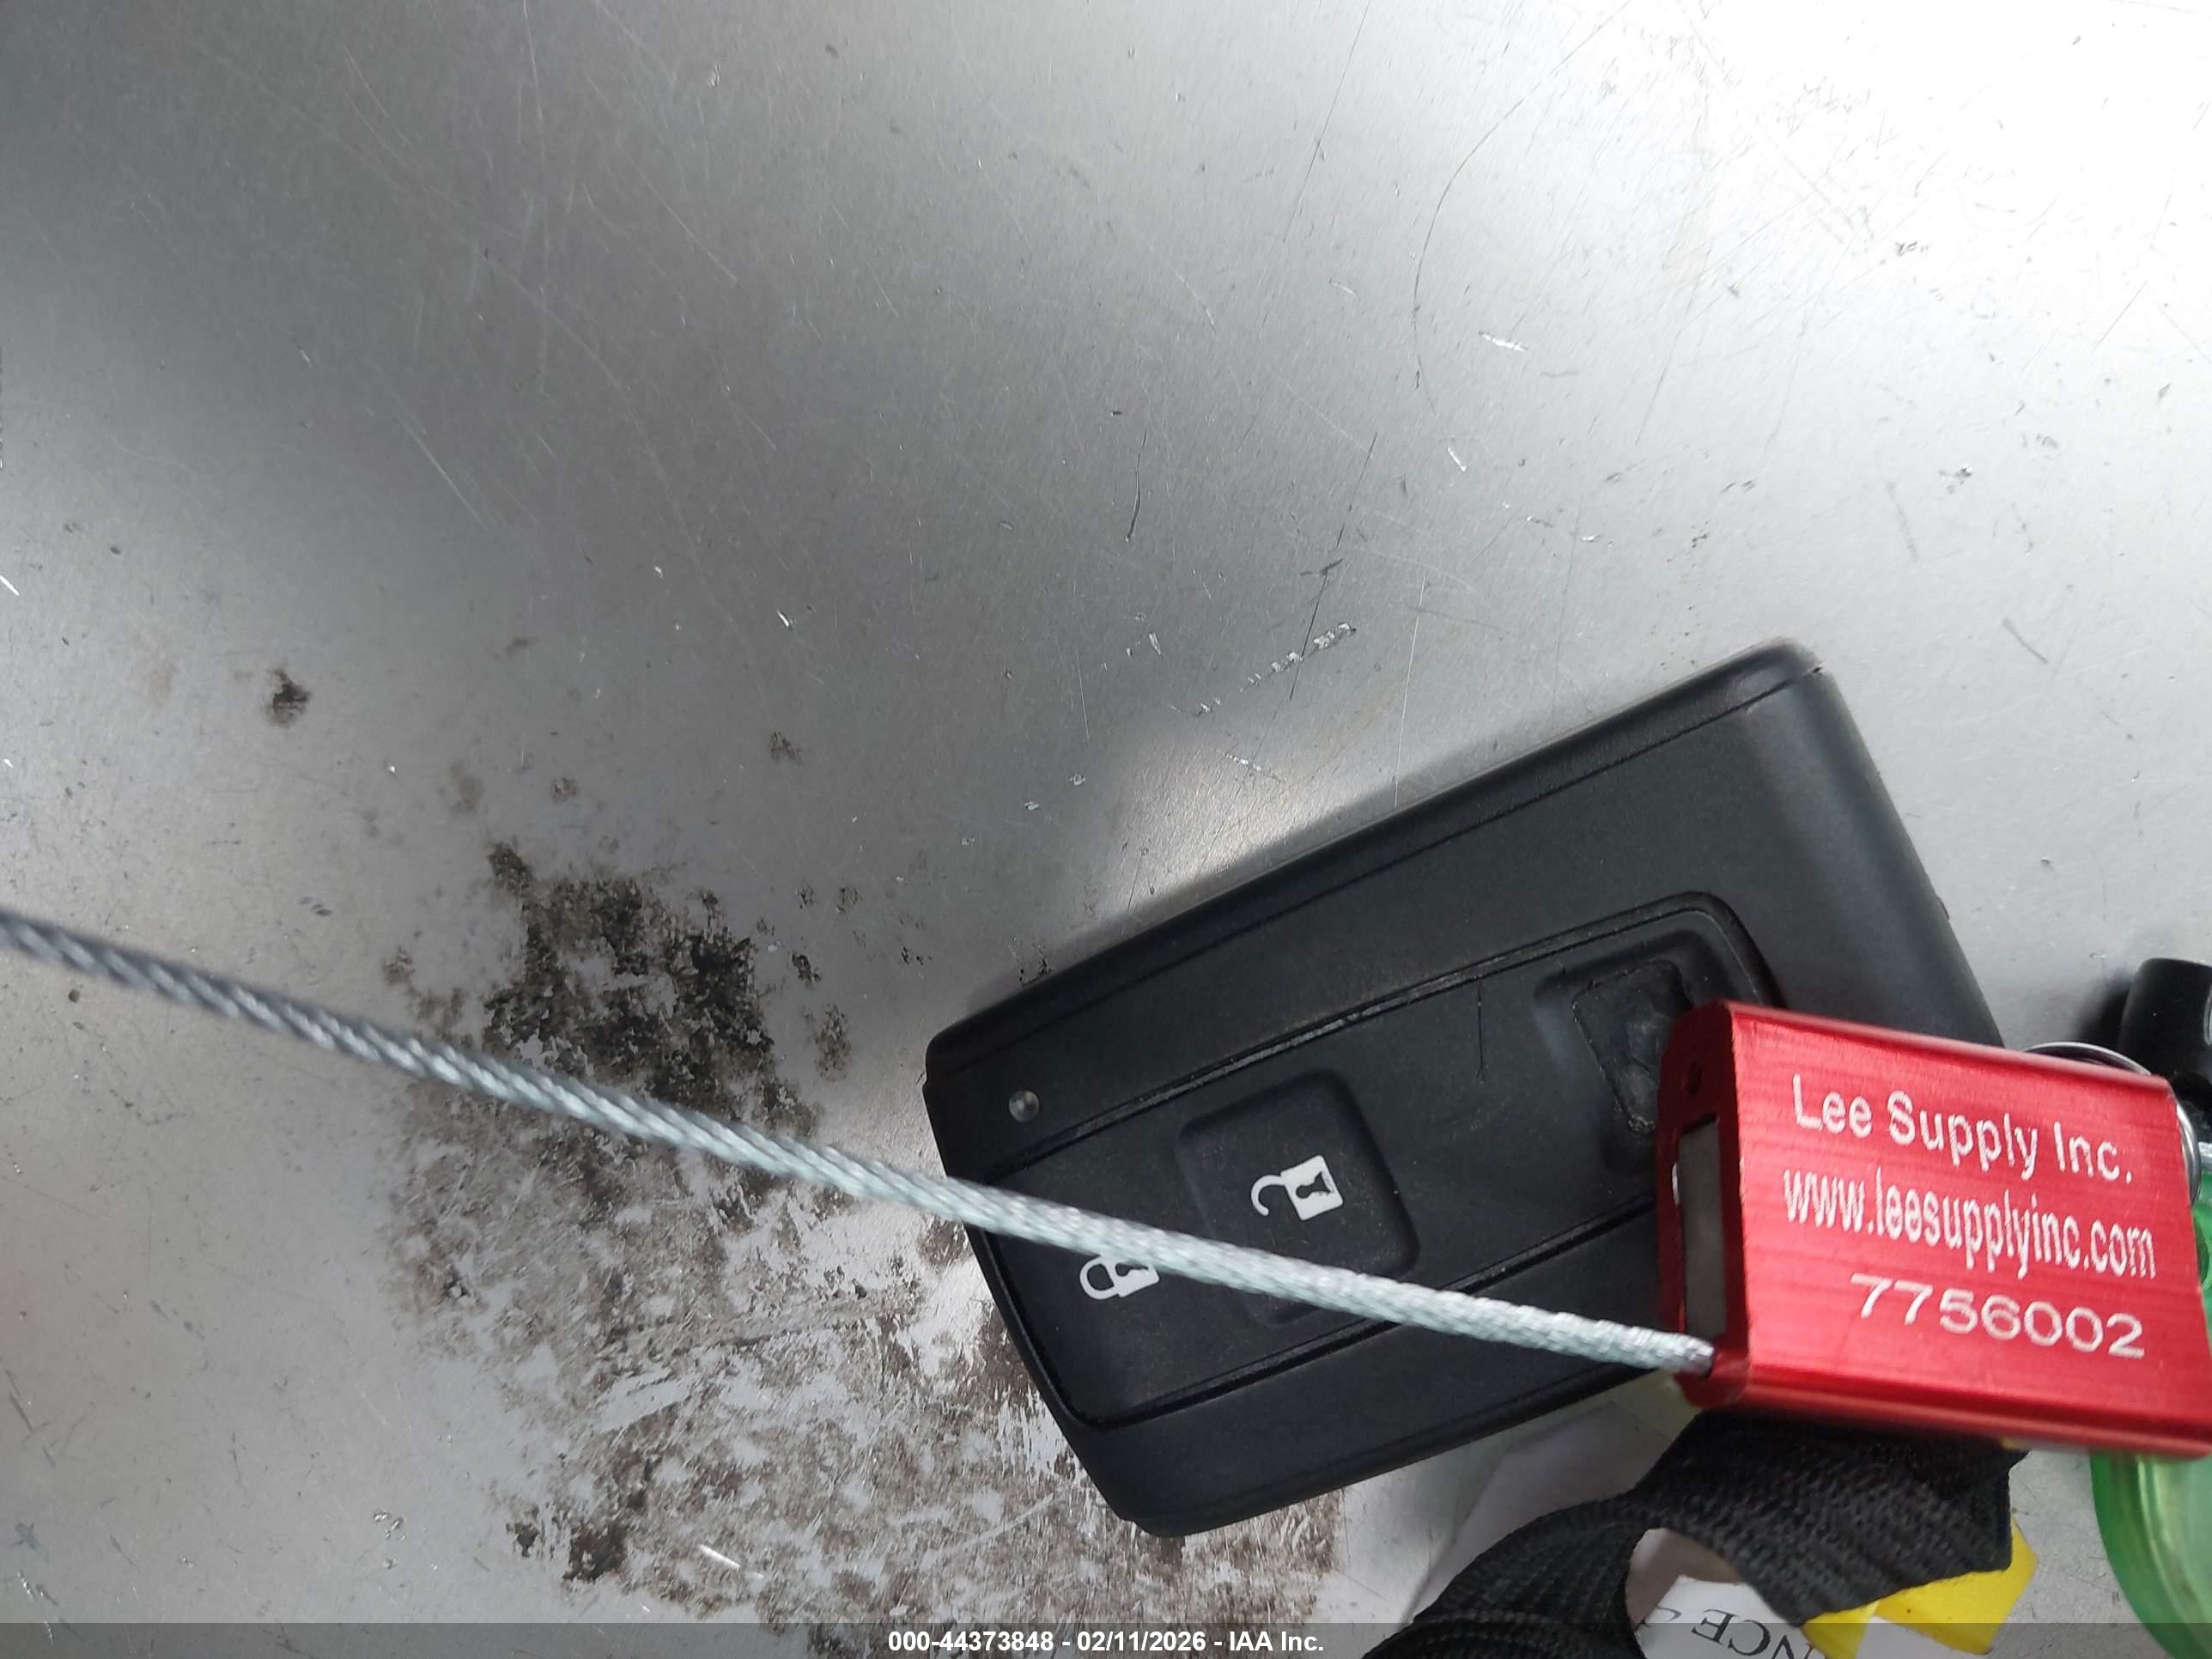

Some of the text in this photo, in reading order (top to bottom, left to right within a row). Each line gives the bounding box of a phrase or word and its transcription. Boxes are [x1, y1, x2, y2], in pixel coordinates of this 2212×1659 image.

[1791, 1073, 2132, 1185] Lee Supply Inc.
[1783, 1165, 2157, 1279] www.leesupplyinc.com
[1850, 1273, 2145, 1358] 7756002
